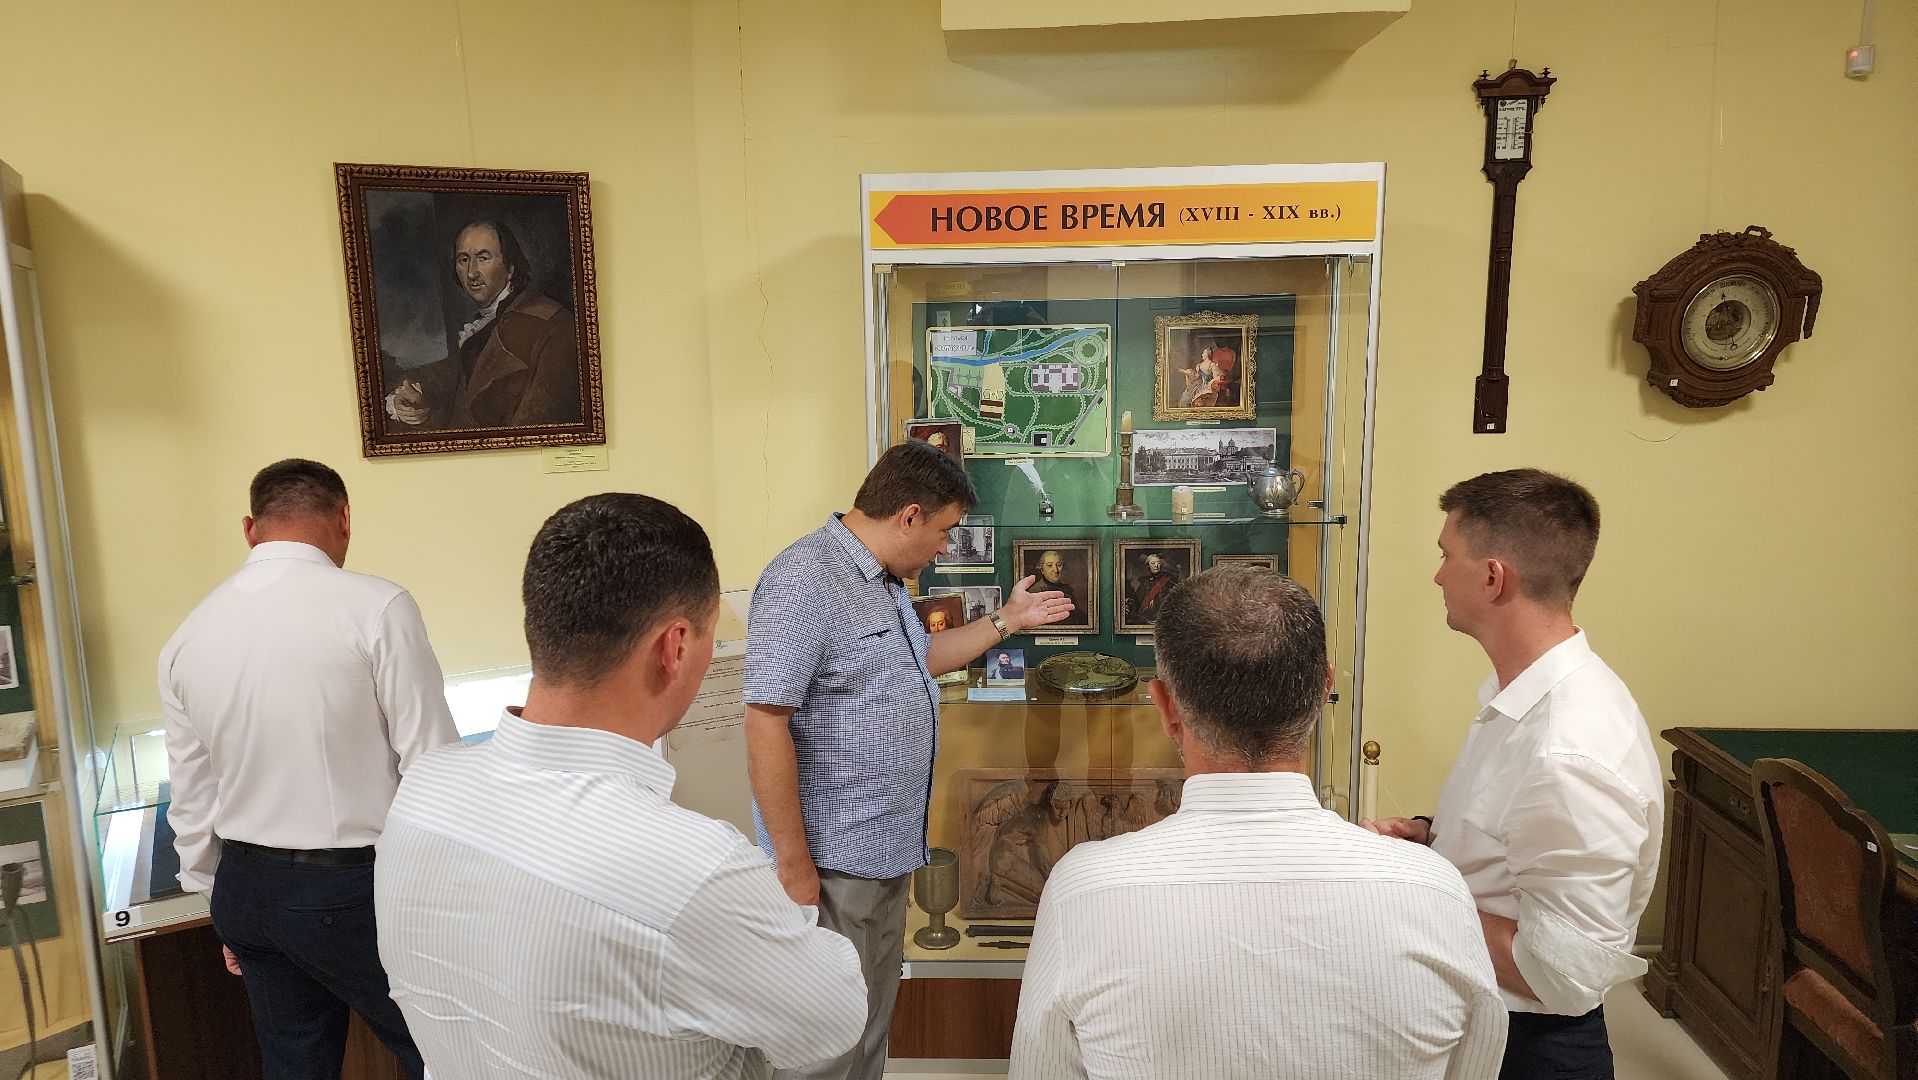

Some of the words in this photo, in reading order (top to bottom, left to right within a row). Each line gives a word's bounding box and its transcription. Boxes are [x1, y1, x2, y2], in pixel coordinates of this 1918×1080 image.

[931, 205, 1048, 232] НОВОЕ
[1061, 202, 1165, 230] ВРЕМЯ
[1179, 206, 1240, 225] (XVIII
[1262, 204, 1300, 220] XIX
[1308, 204, 1341, 222] вв.)
[115, 910, 131, 927] 9
